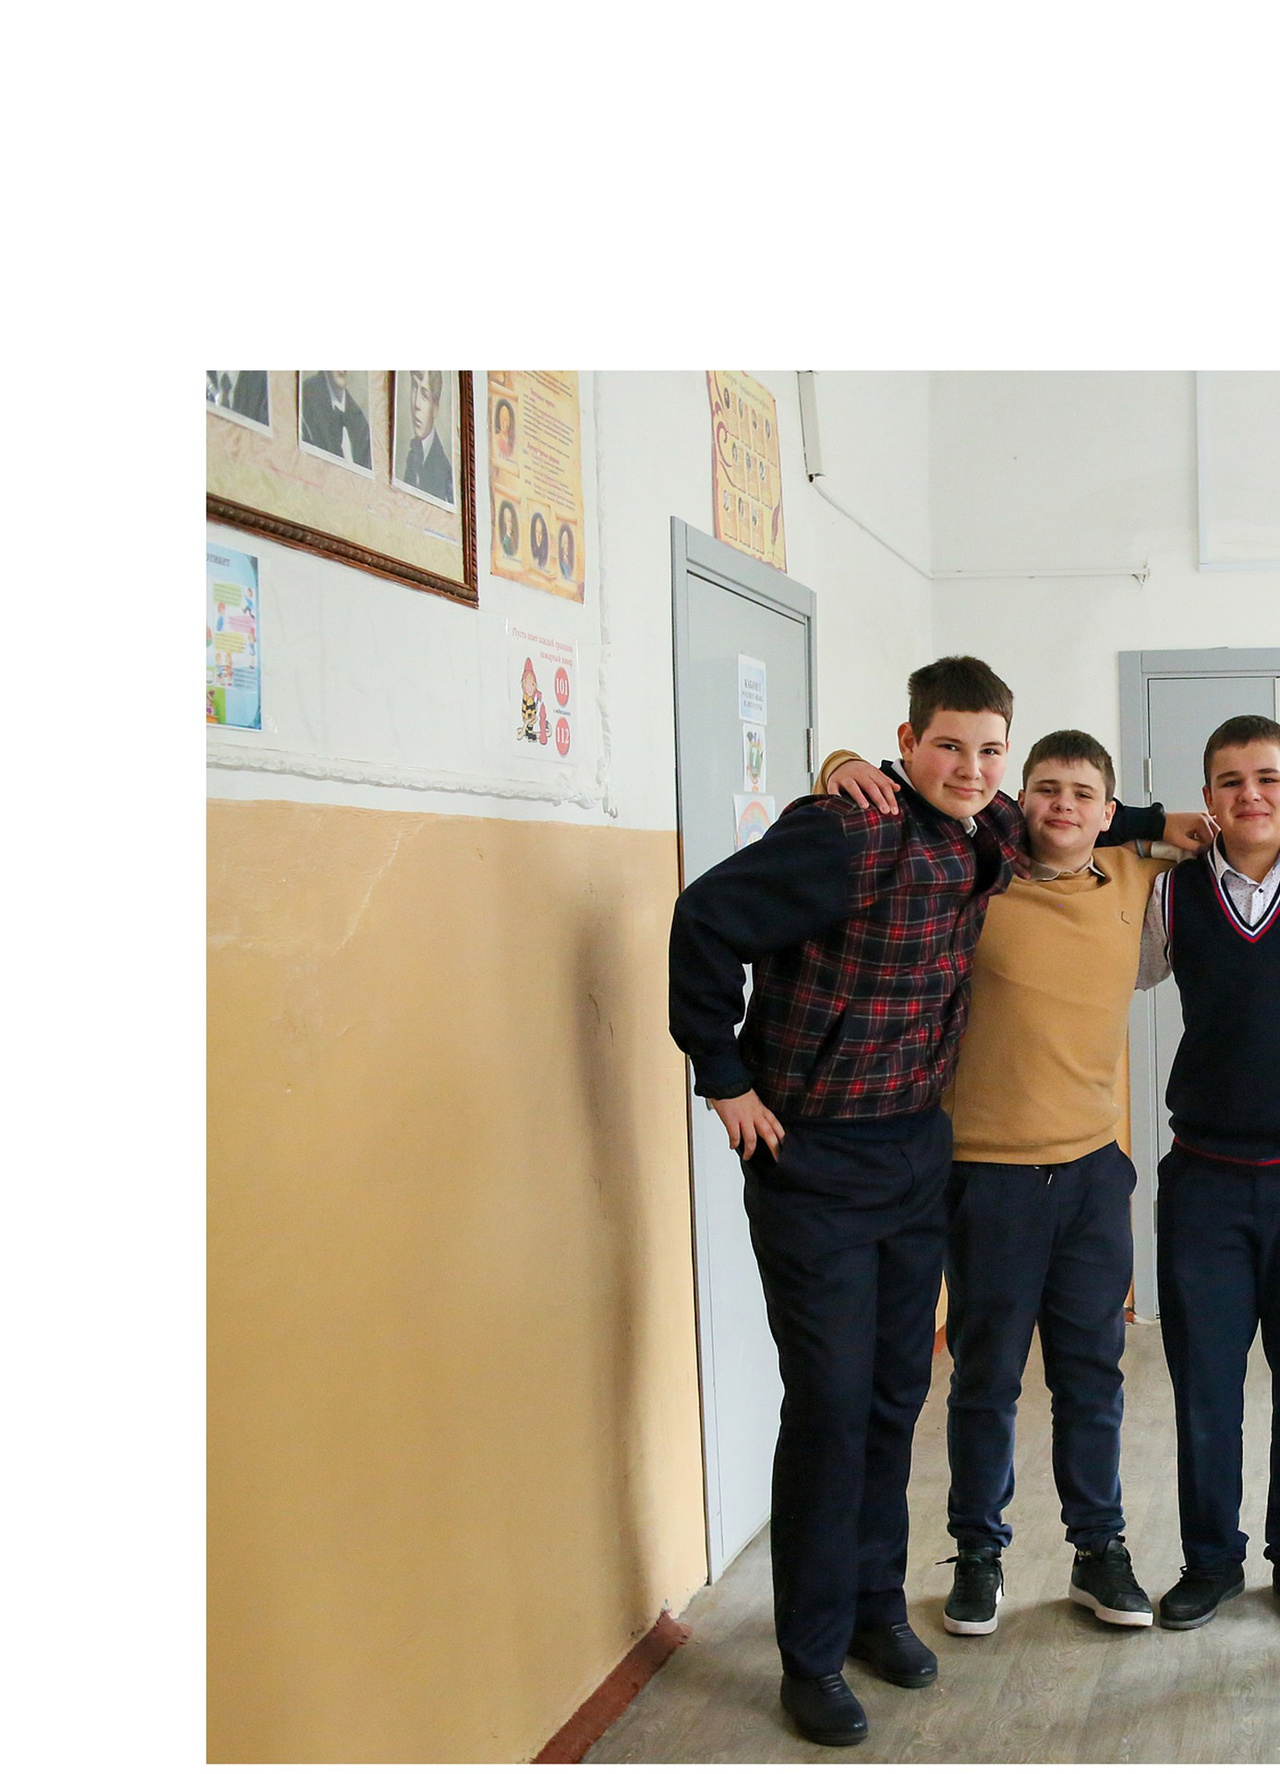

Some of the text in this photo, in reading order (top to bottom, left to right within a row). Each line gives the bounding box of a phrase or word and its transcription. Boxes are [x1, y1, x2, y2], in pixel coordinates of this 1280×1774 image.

[556, 678, 568, 695] 101
[556, 727, 570, 744] 112
[751, 746, 757, 767] 7
